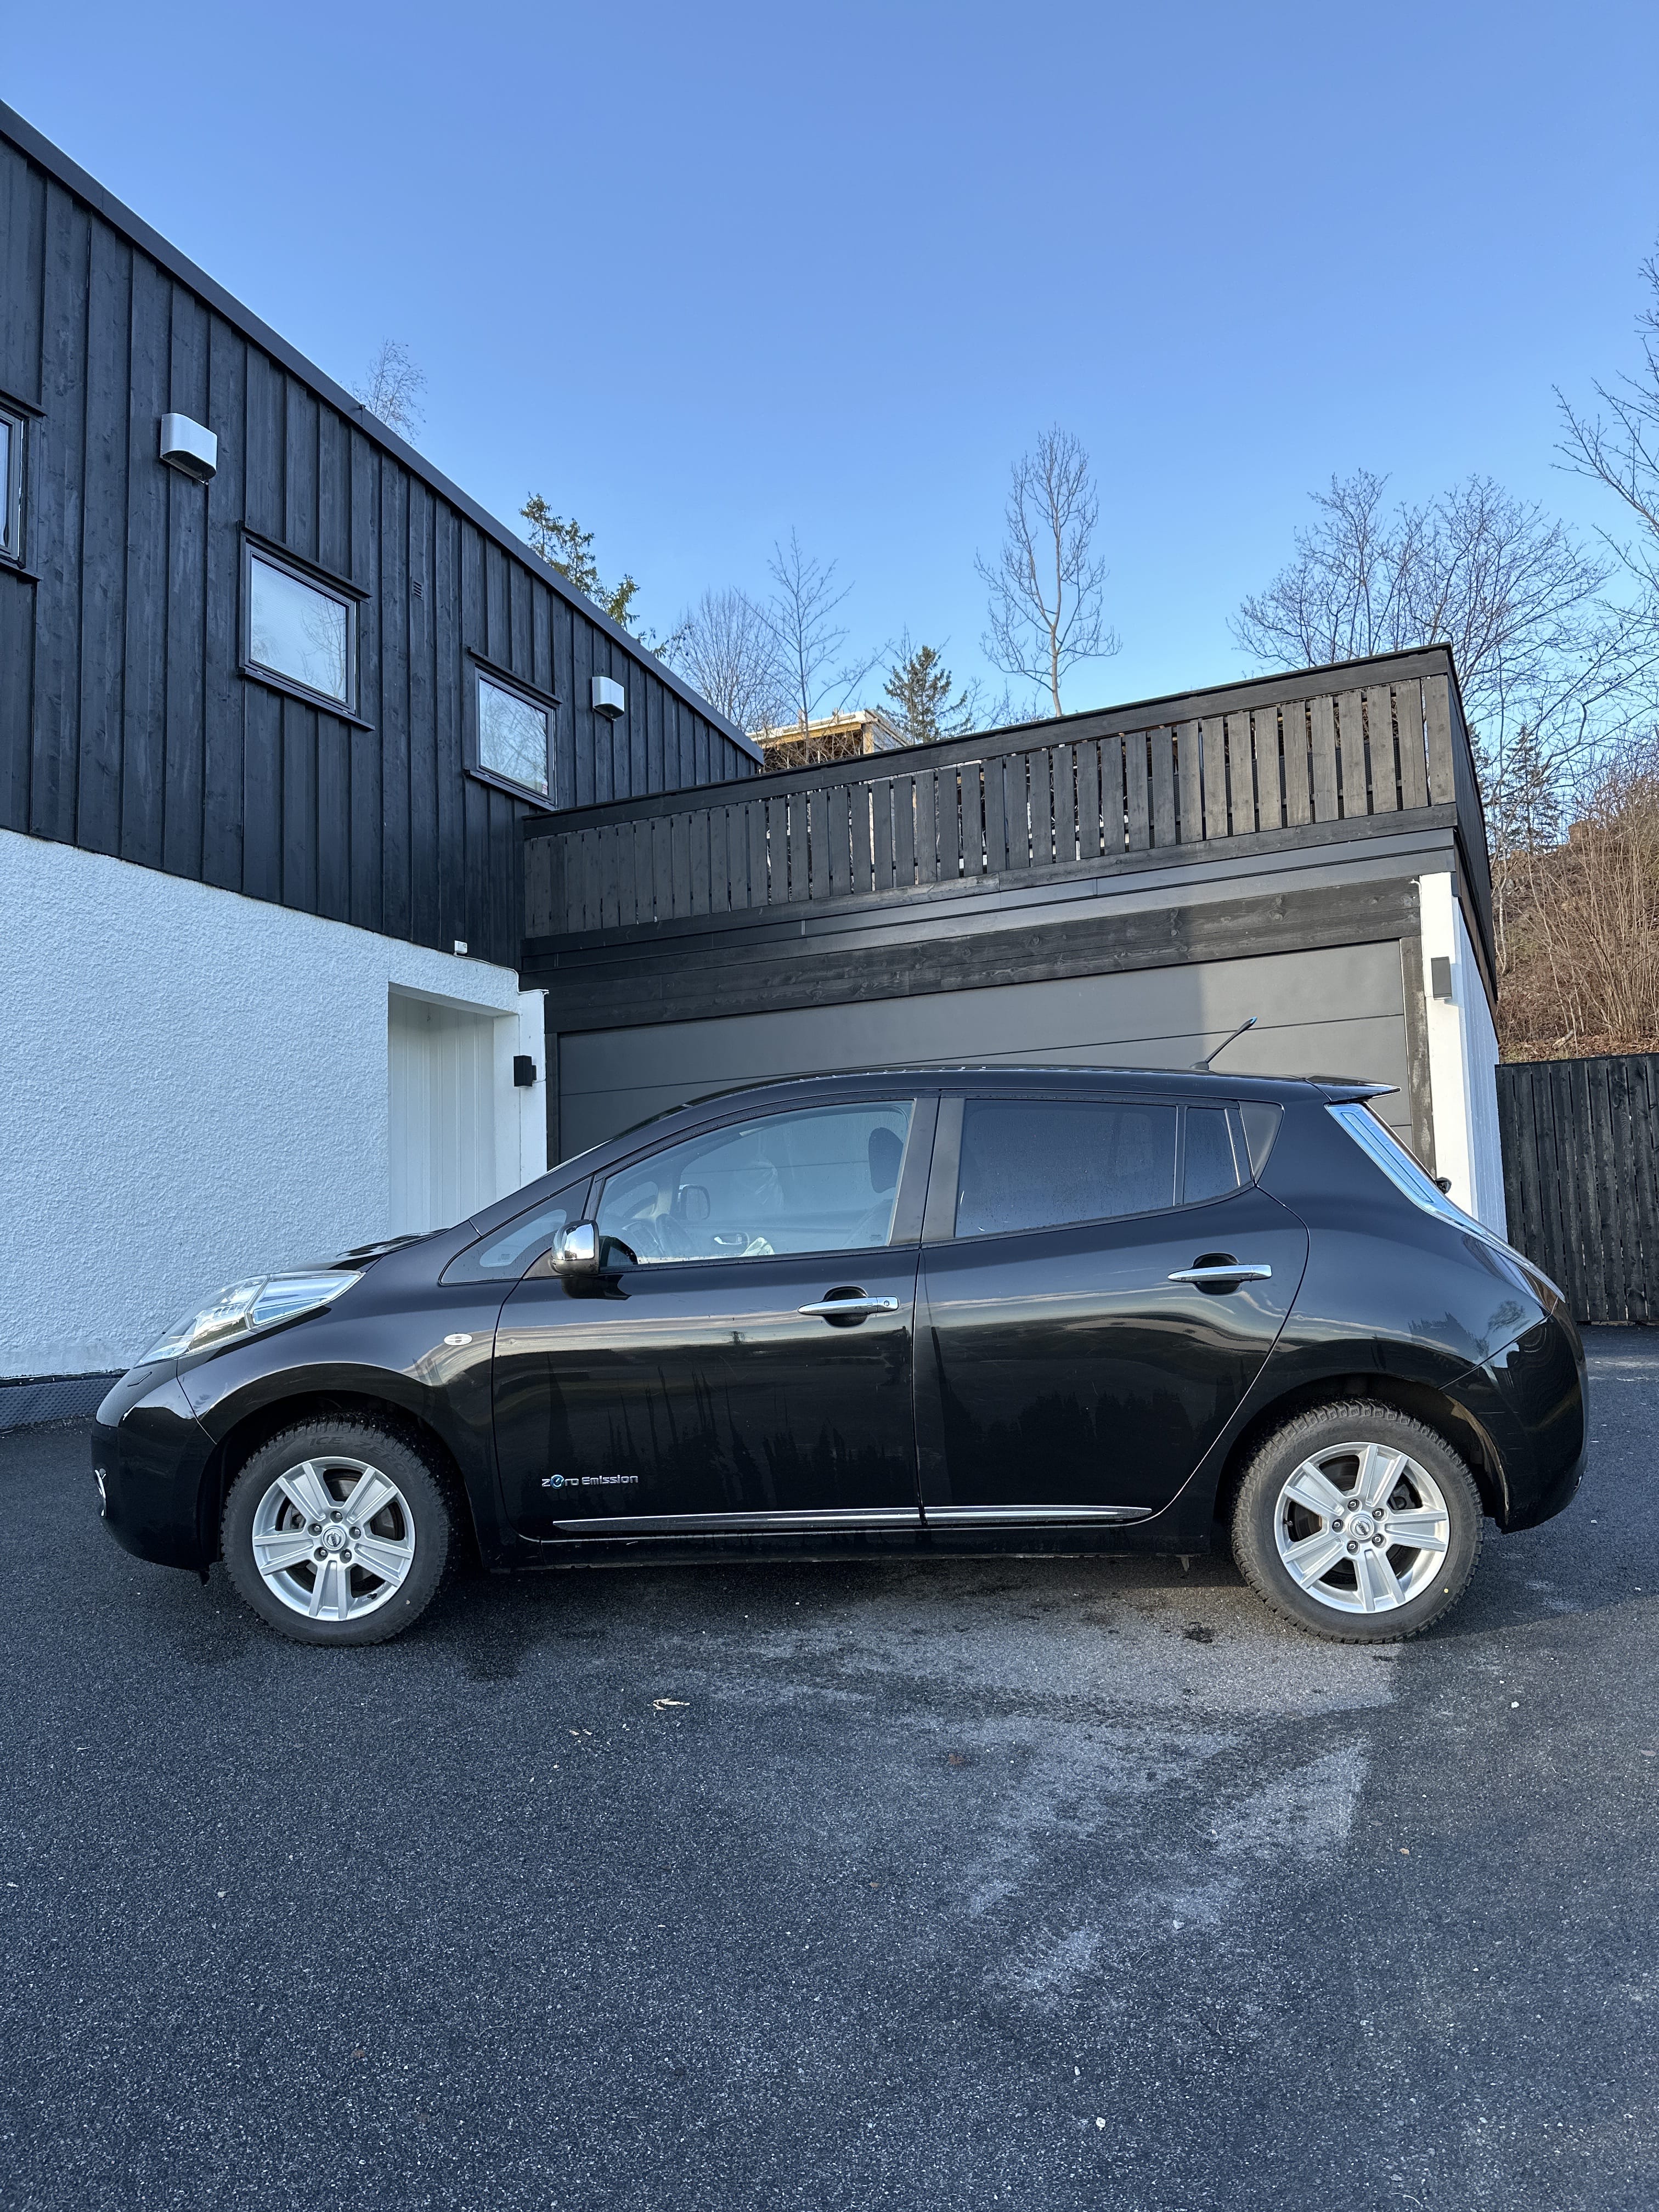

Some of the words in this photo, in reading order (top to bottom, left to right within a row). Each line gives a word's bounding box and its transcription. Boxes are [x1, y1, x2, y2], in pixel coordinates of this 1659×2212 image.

[309, 1436, 344, 1447] ICE
[354, 1441, 405, 1471] ZERO
[582, 1474, 639, 1485] Emission
